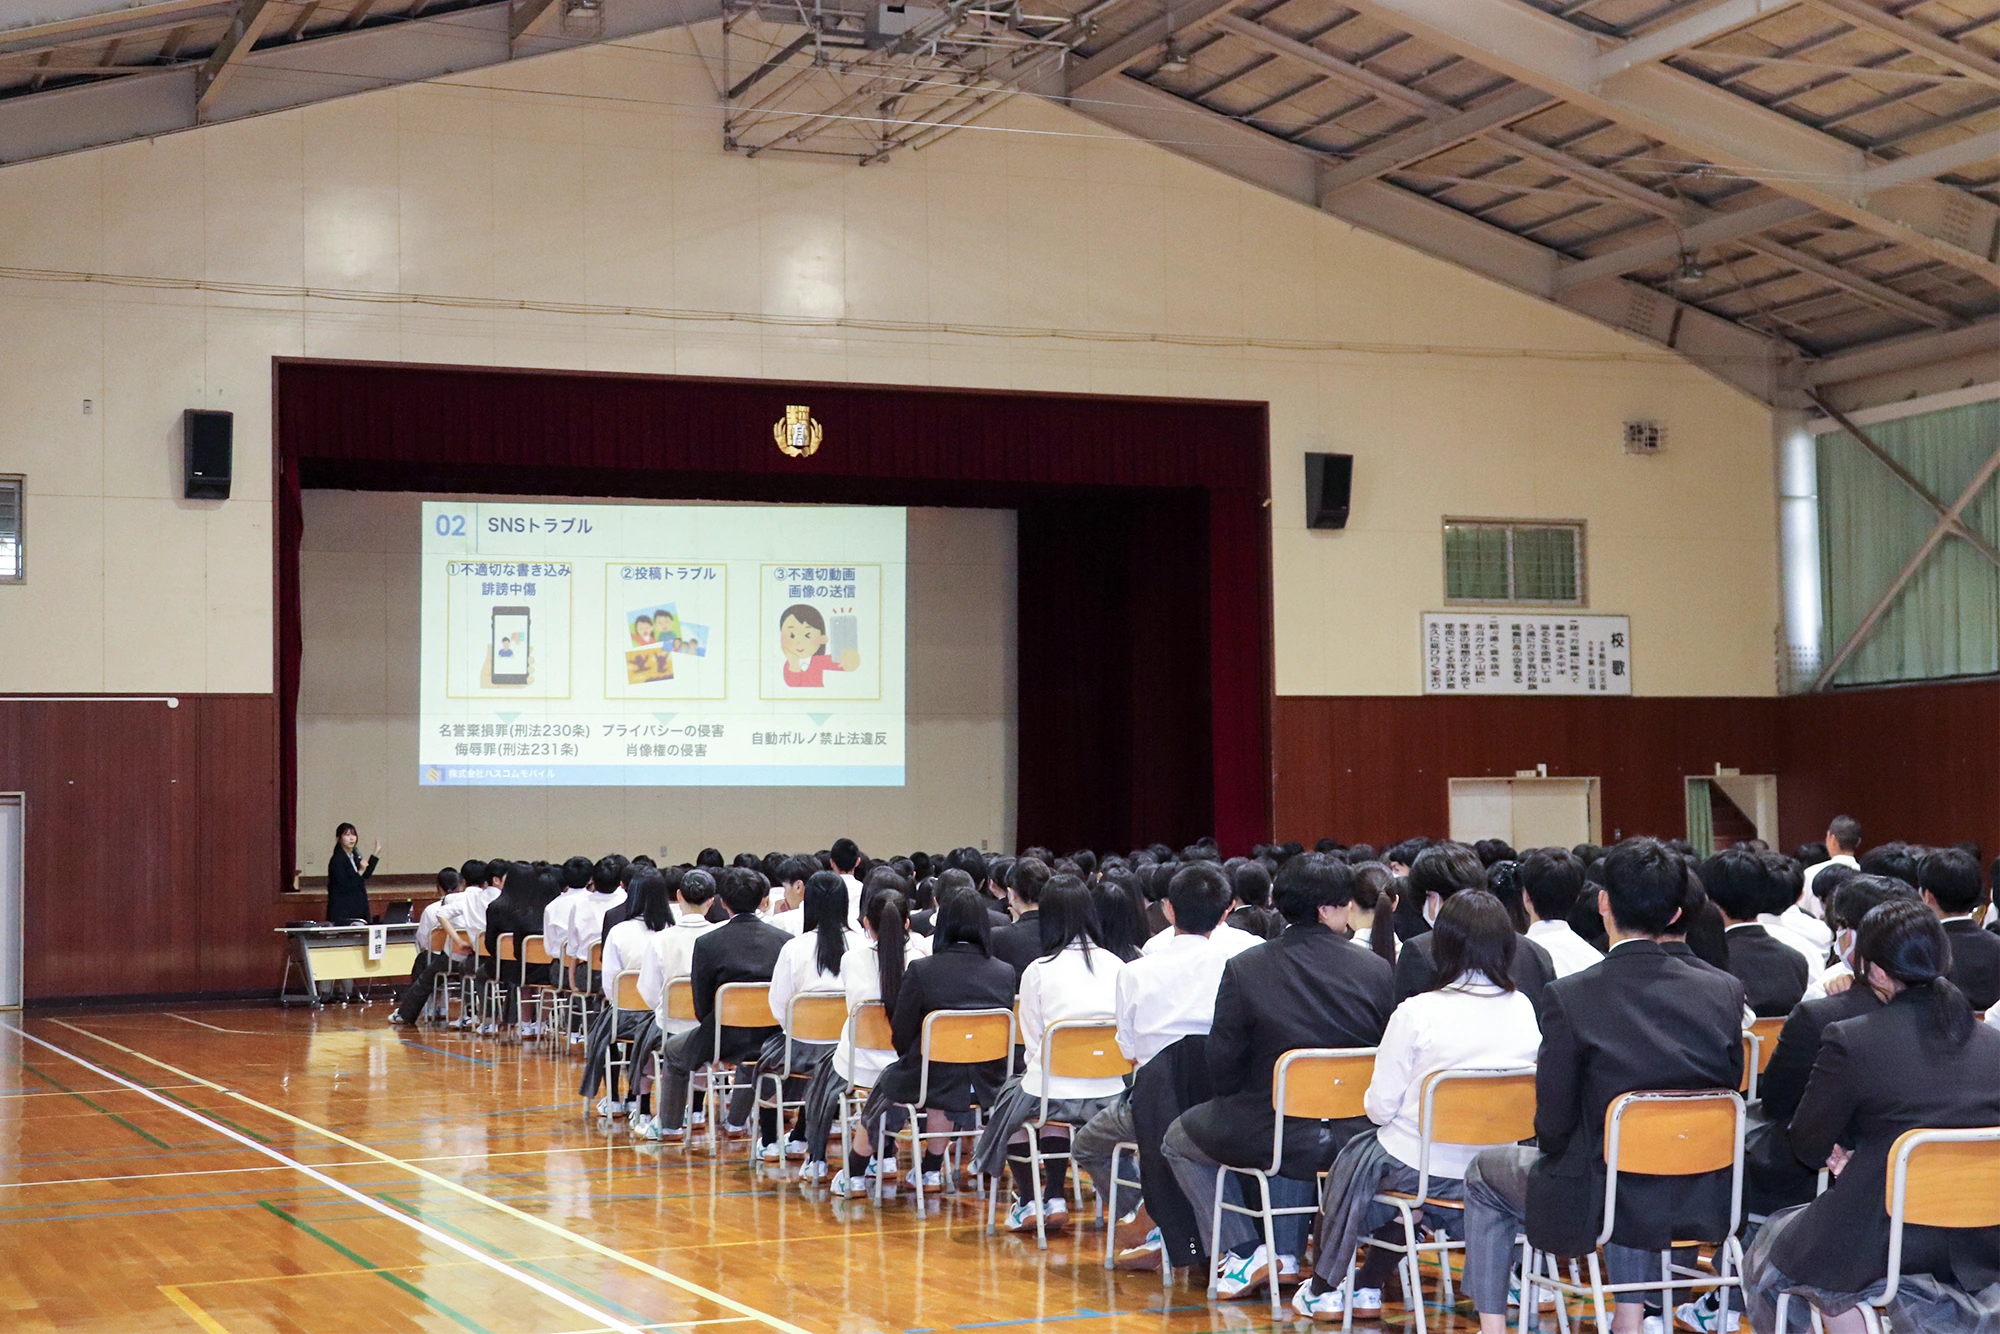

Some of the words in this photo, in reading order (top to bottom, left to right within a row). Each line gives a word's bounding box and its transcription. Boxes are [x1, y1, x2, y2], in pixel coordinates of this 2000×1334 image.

[435, 514, 466, 537] 02
[488, 517, 593, 534] SNSトラブル
[620, 566, 716, 581] ②投稿トラブル
[774, 567, 856, 582] ③不適切動画
[481, 582, 537, 597] 誹謗中傷
[788, 584, 856, 599] 画像の送信
[602, 723, 725, 738] プライバシーの侵害
[454, 742, 579, 757] 侮辱罪(刑法231条)
[626, 743, 707, 757] 肖像権の侵害
